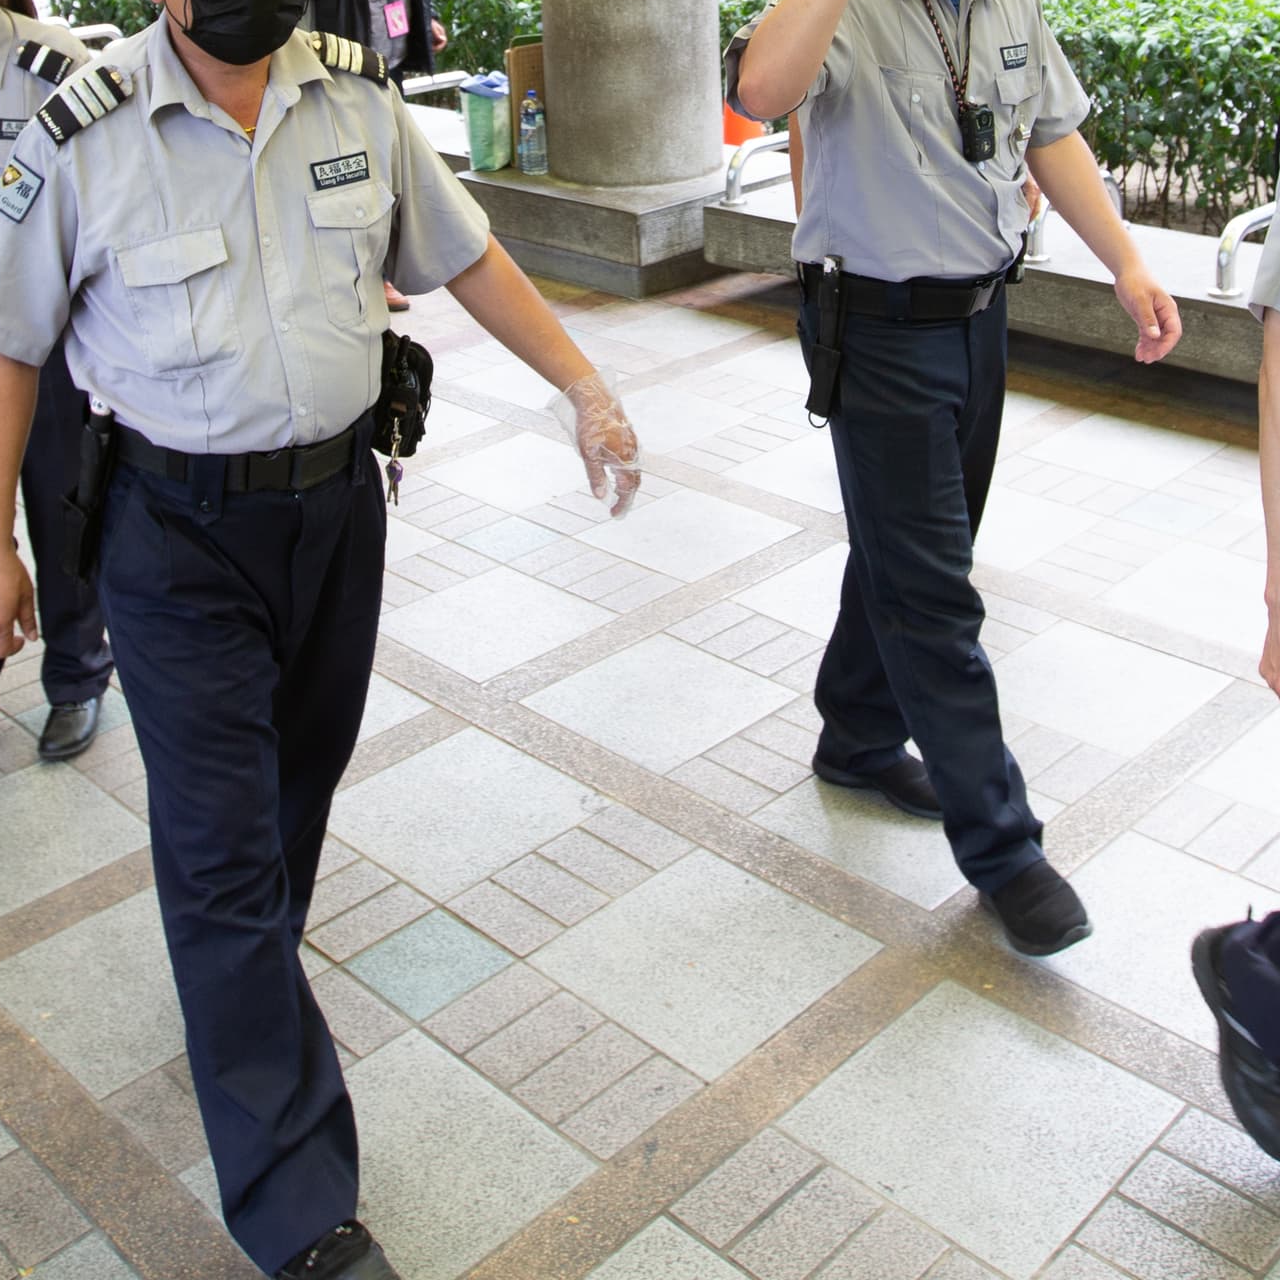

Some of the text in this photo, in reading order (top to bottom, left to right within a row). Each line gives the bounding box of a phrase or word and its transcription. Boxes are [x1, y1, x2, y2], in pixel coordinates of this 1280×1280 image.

[319, 157, 365, 178] 良福保全
[15, 180, 33, 200] 福
[1, 194, 24, 215] Guard
